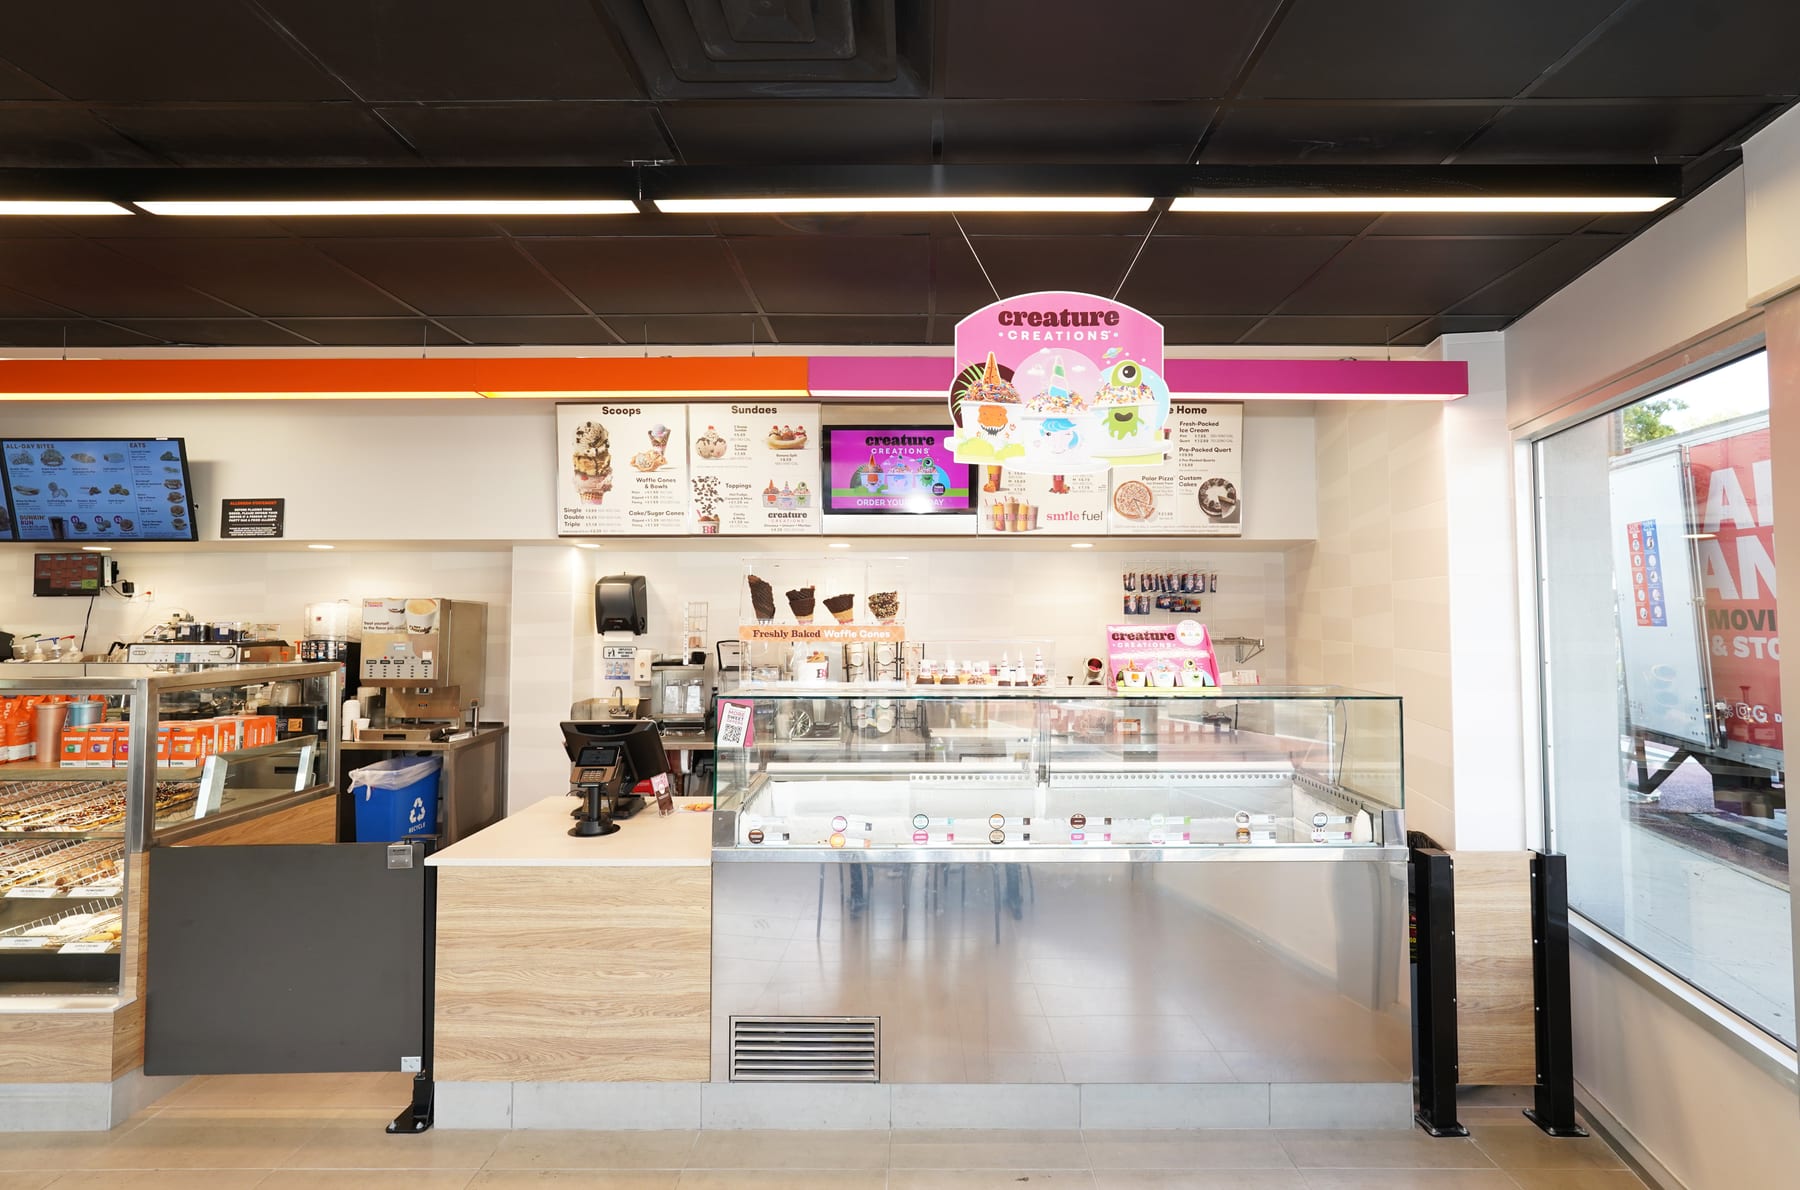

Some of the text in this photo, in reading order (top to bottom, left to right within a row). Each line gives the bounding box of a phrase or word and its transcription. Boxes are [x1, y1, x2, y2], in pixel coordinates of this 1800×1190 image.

[998, 309, 1120, 327] creature
[1008, 330, 1111, 342] CREATIONS
[602, 406, 641, 416] Scoops
[731, 405, 778, 414] Sundaes
[1176, 406, 1208, 414] Home
[865, 434, 935, 446] creature
[1081, 510, 1103, 521] fuel
[753, 630, 788, 639] Freshly
[792, 630, 820, 638] Baked
[824, 630, 856, 638] Waffle
[1112, 630, 1175, 641] creature
[1712, 635, 1728, 656] &
[409, 822, 426, 833] RECYCLE
